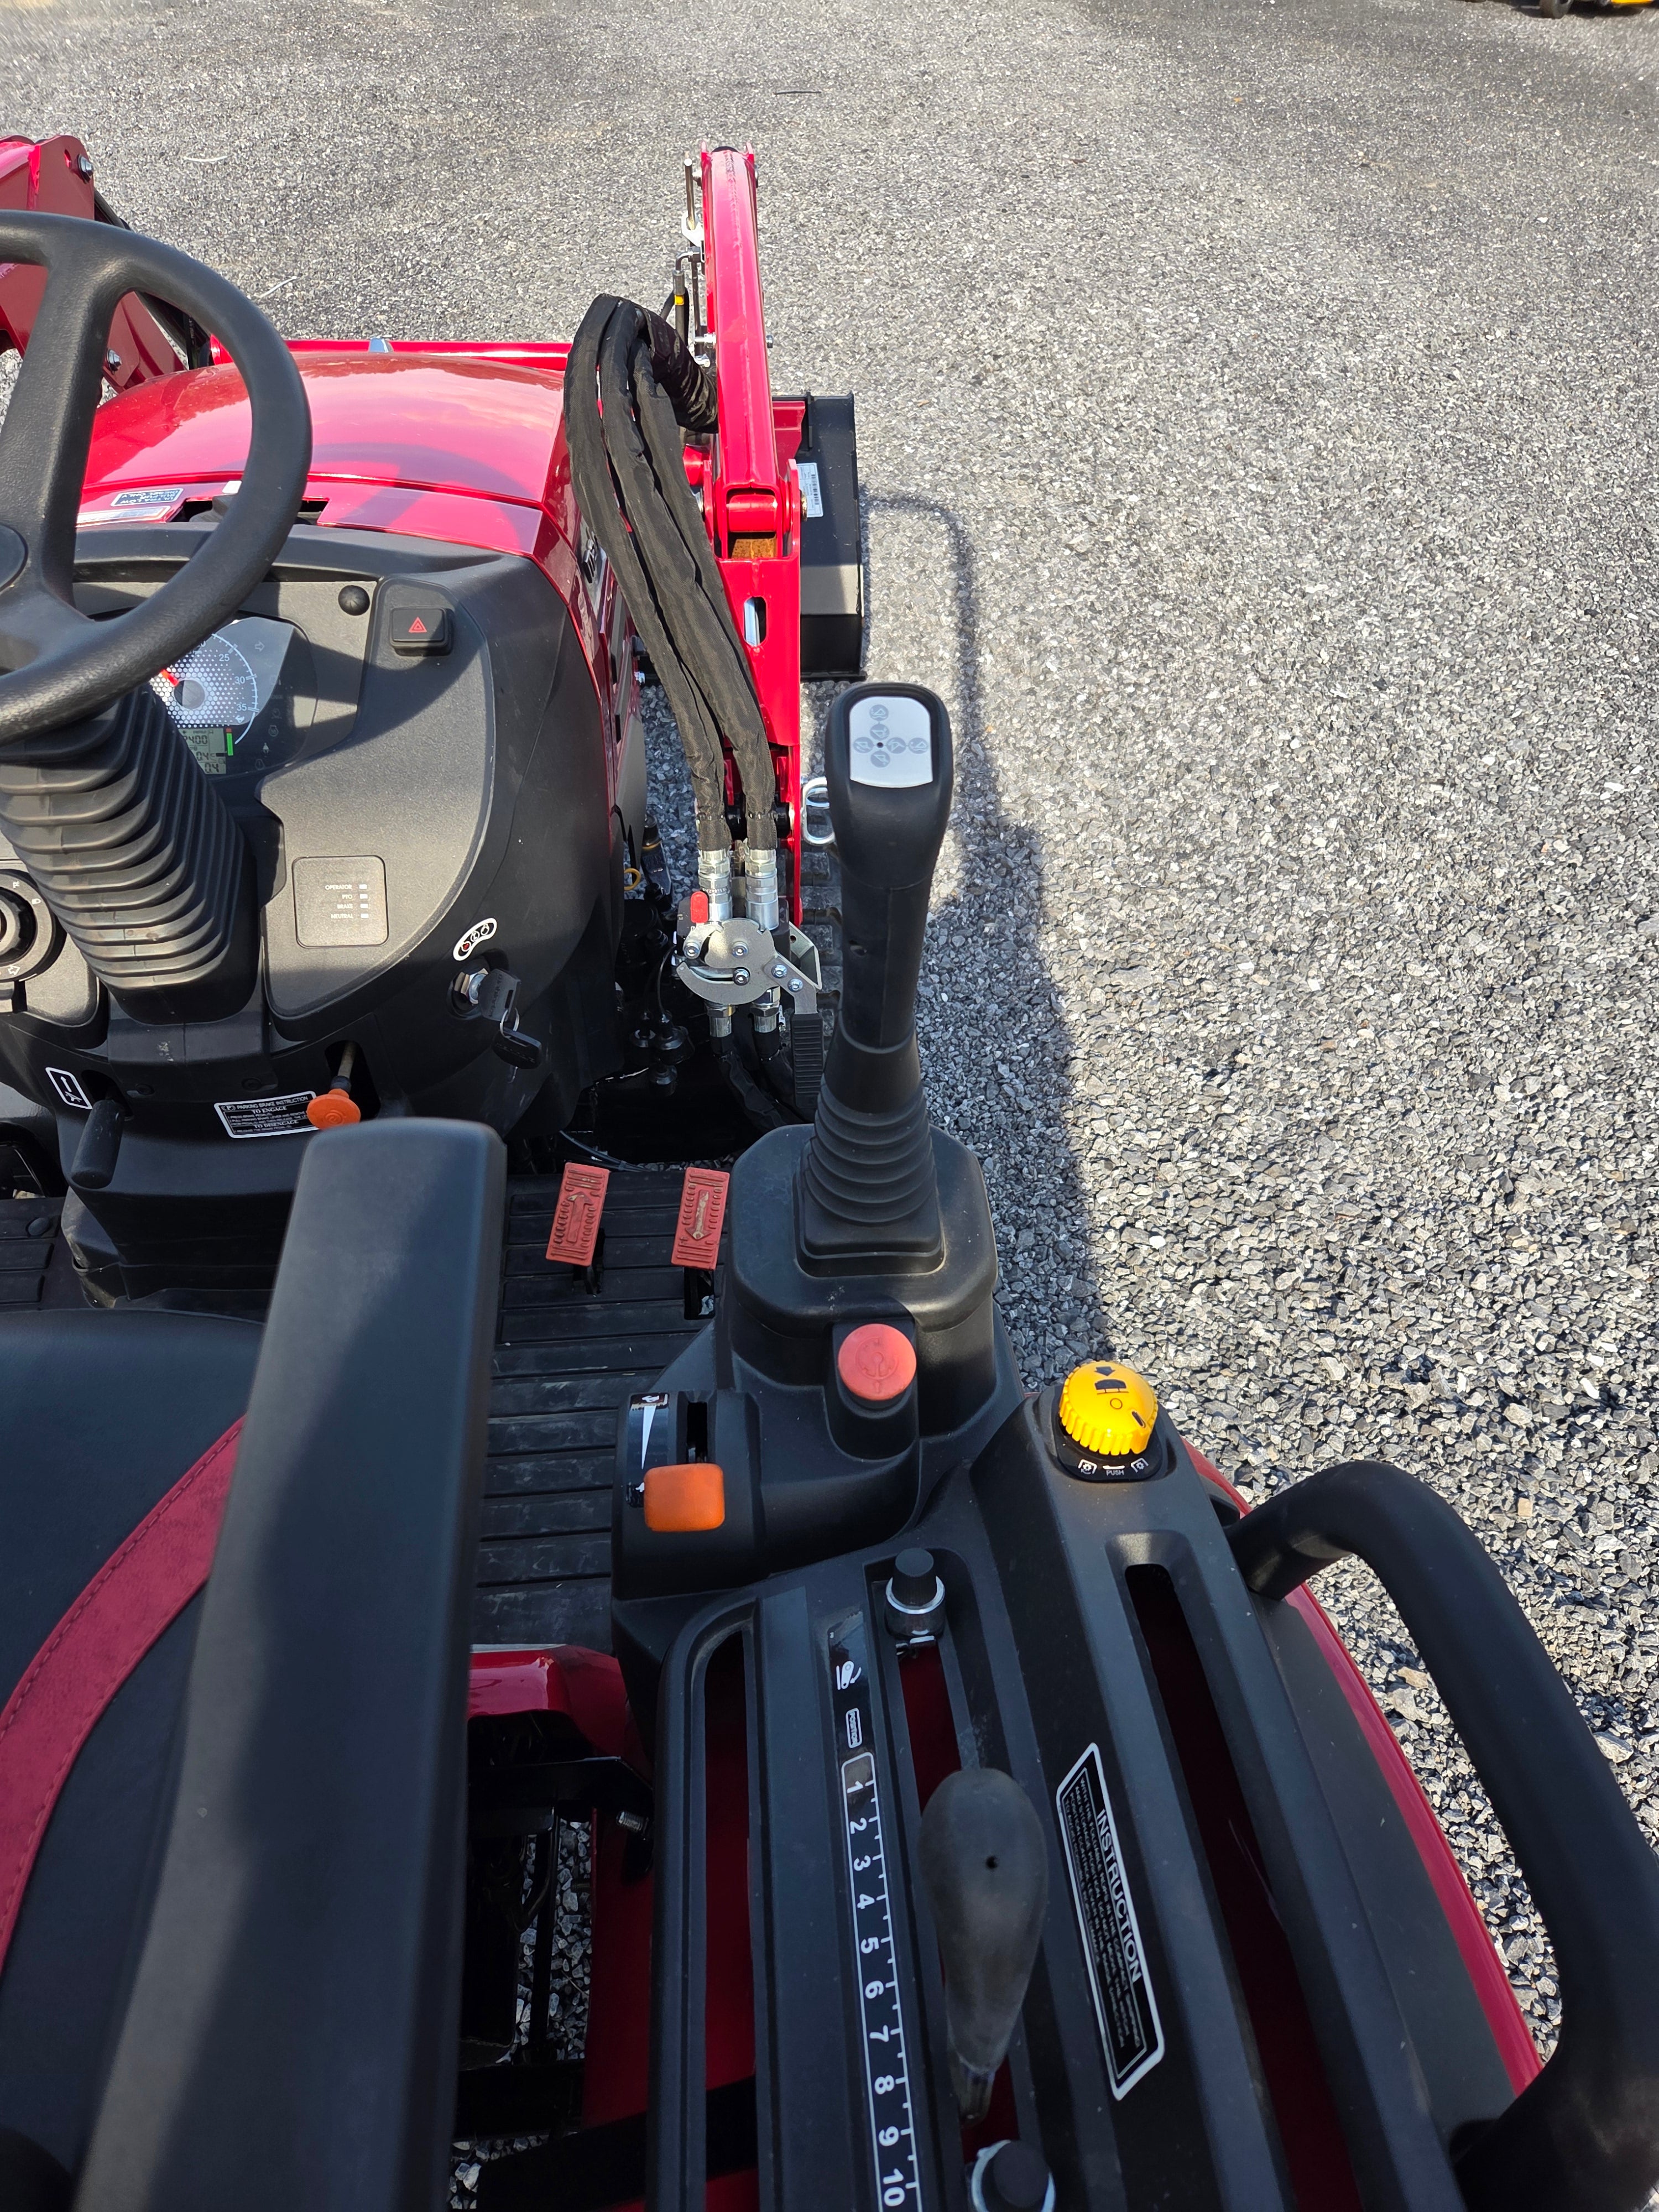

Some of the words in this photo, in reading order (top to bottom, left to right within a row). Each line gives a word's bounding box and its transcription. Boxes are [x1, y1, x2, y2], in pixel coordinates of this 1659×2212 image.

[276, 1095, 308, 1105] INSTRUCTION
[847, 1780, 863, 1793] 1
[850, 1817, 867, 1834] 2
[853, 1855, 871, 1871] 3
[857, 1893, 875, 1910] 4
[1096, 1808, 1142, 1984] INSTRUCTION
[861, 1937, 879, 1954] 5
[865, 1980, 884, 1999] 6
[869, 2025, 889, 2042] 7
[874, 2075, 895, 2095] 8
[879, 2126, 899, 2146] 9
[883, 2168, 905, 2206] 10
